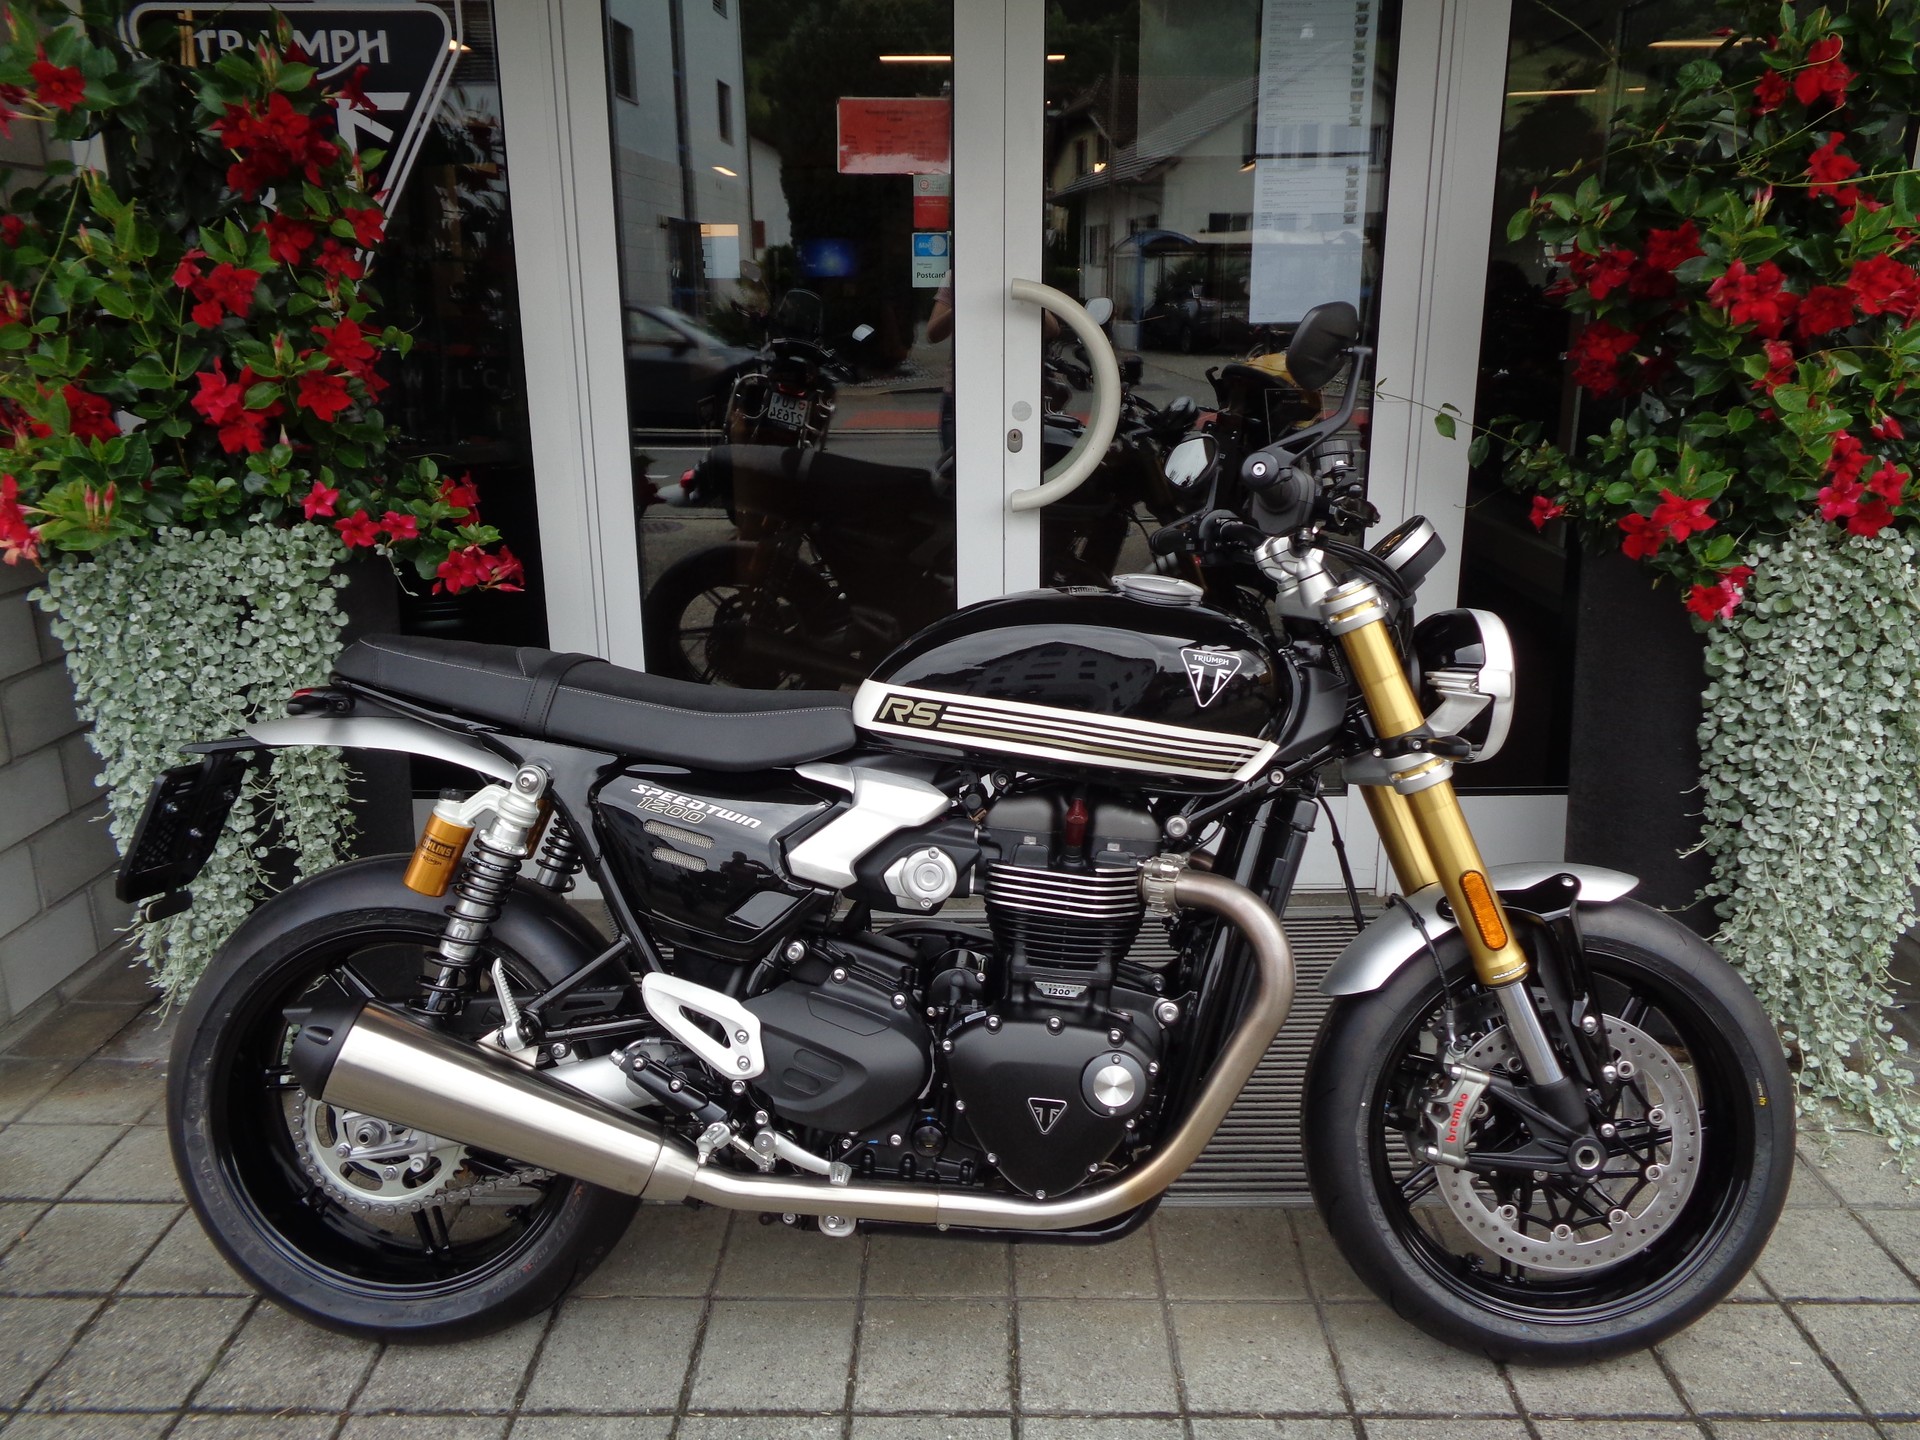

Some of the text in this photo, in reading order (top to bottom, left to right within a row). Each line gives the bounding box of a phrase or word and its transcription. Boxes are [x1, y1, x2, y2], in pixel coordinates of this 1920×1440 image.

[193, 29, 389, 80] TRMPH
[1193, 654, 1229, 667] TRIUMPH
[879, 697, 942, 726] RS
[631, 784, 762, 829] SPEED TWIN
[637, 797, 706, 824] 1200
[1445, 1093, 1468, 1142] brembo
